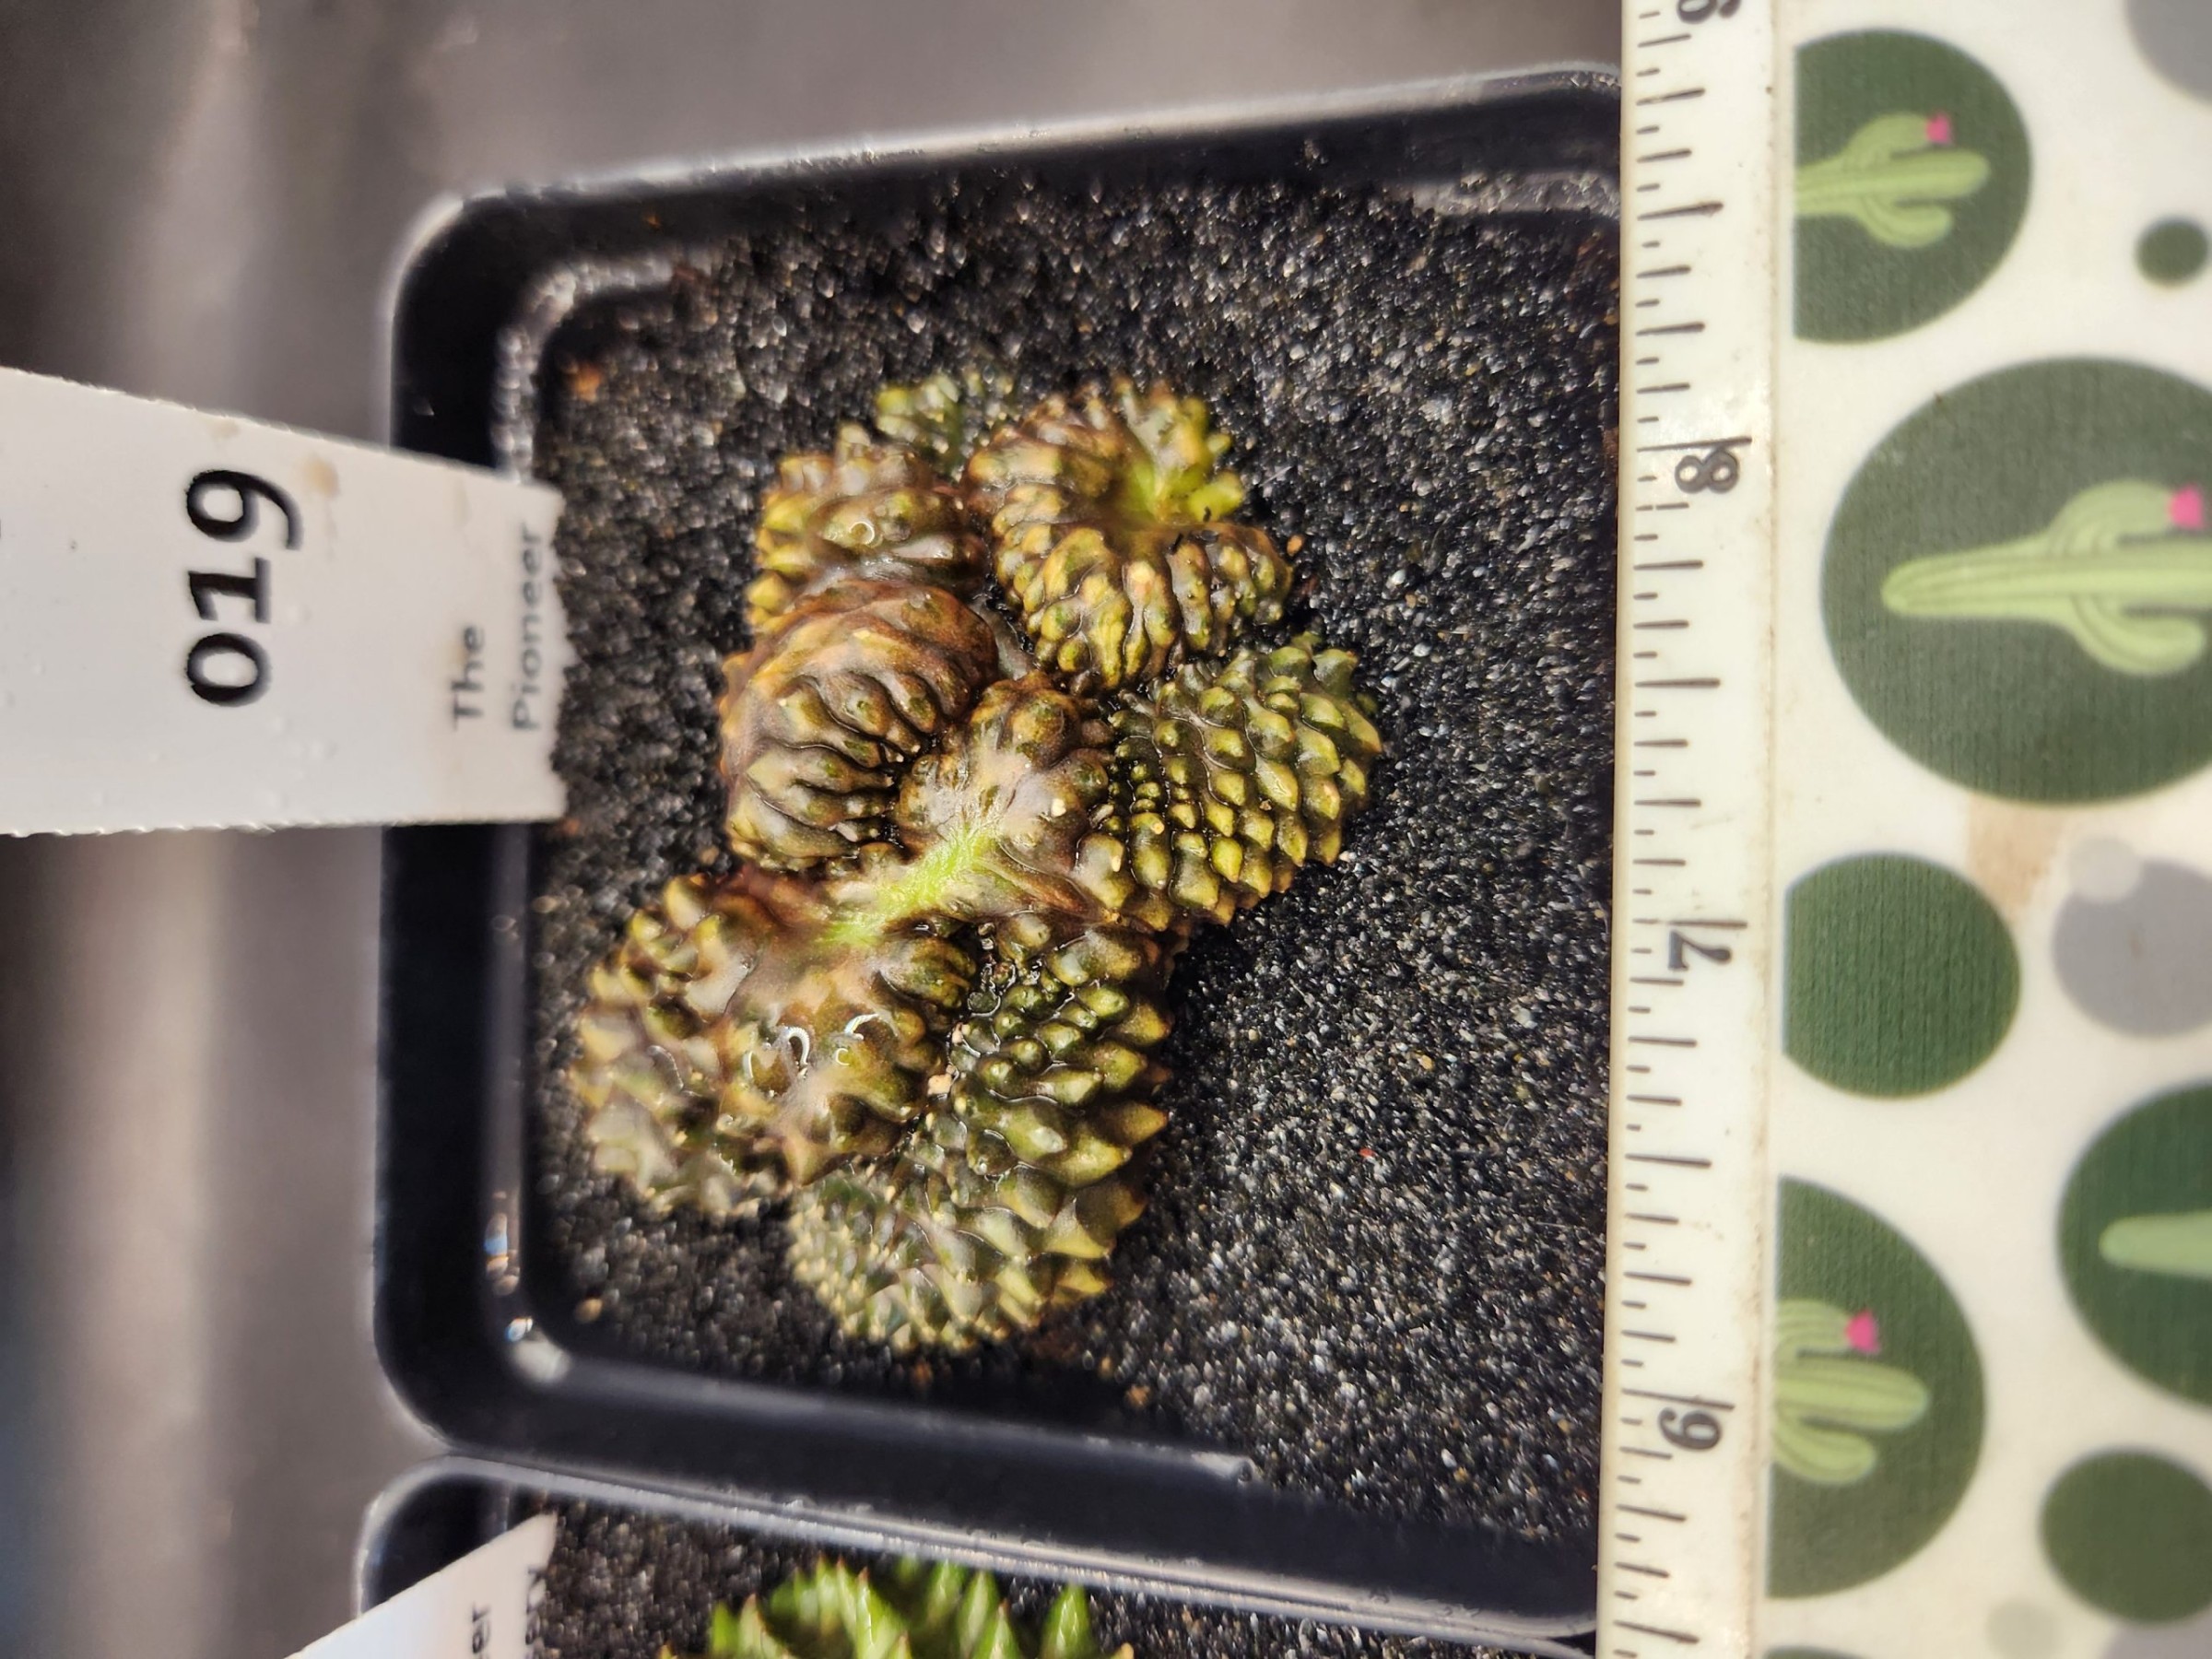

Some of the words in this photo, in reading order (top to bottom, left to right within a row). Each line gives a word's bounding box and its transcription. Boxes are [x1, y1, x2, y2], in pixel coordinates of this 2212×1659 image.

[1675, 448, 1739, 493] 8
[186, 469, 303, 708] 019
[512, 523, 541, 730] Pioneer
[451, 625, 485, 731] The
[1668, 931, 1733, 971] 7
[1658, 1407, 1723, 1451] 6
